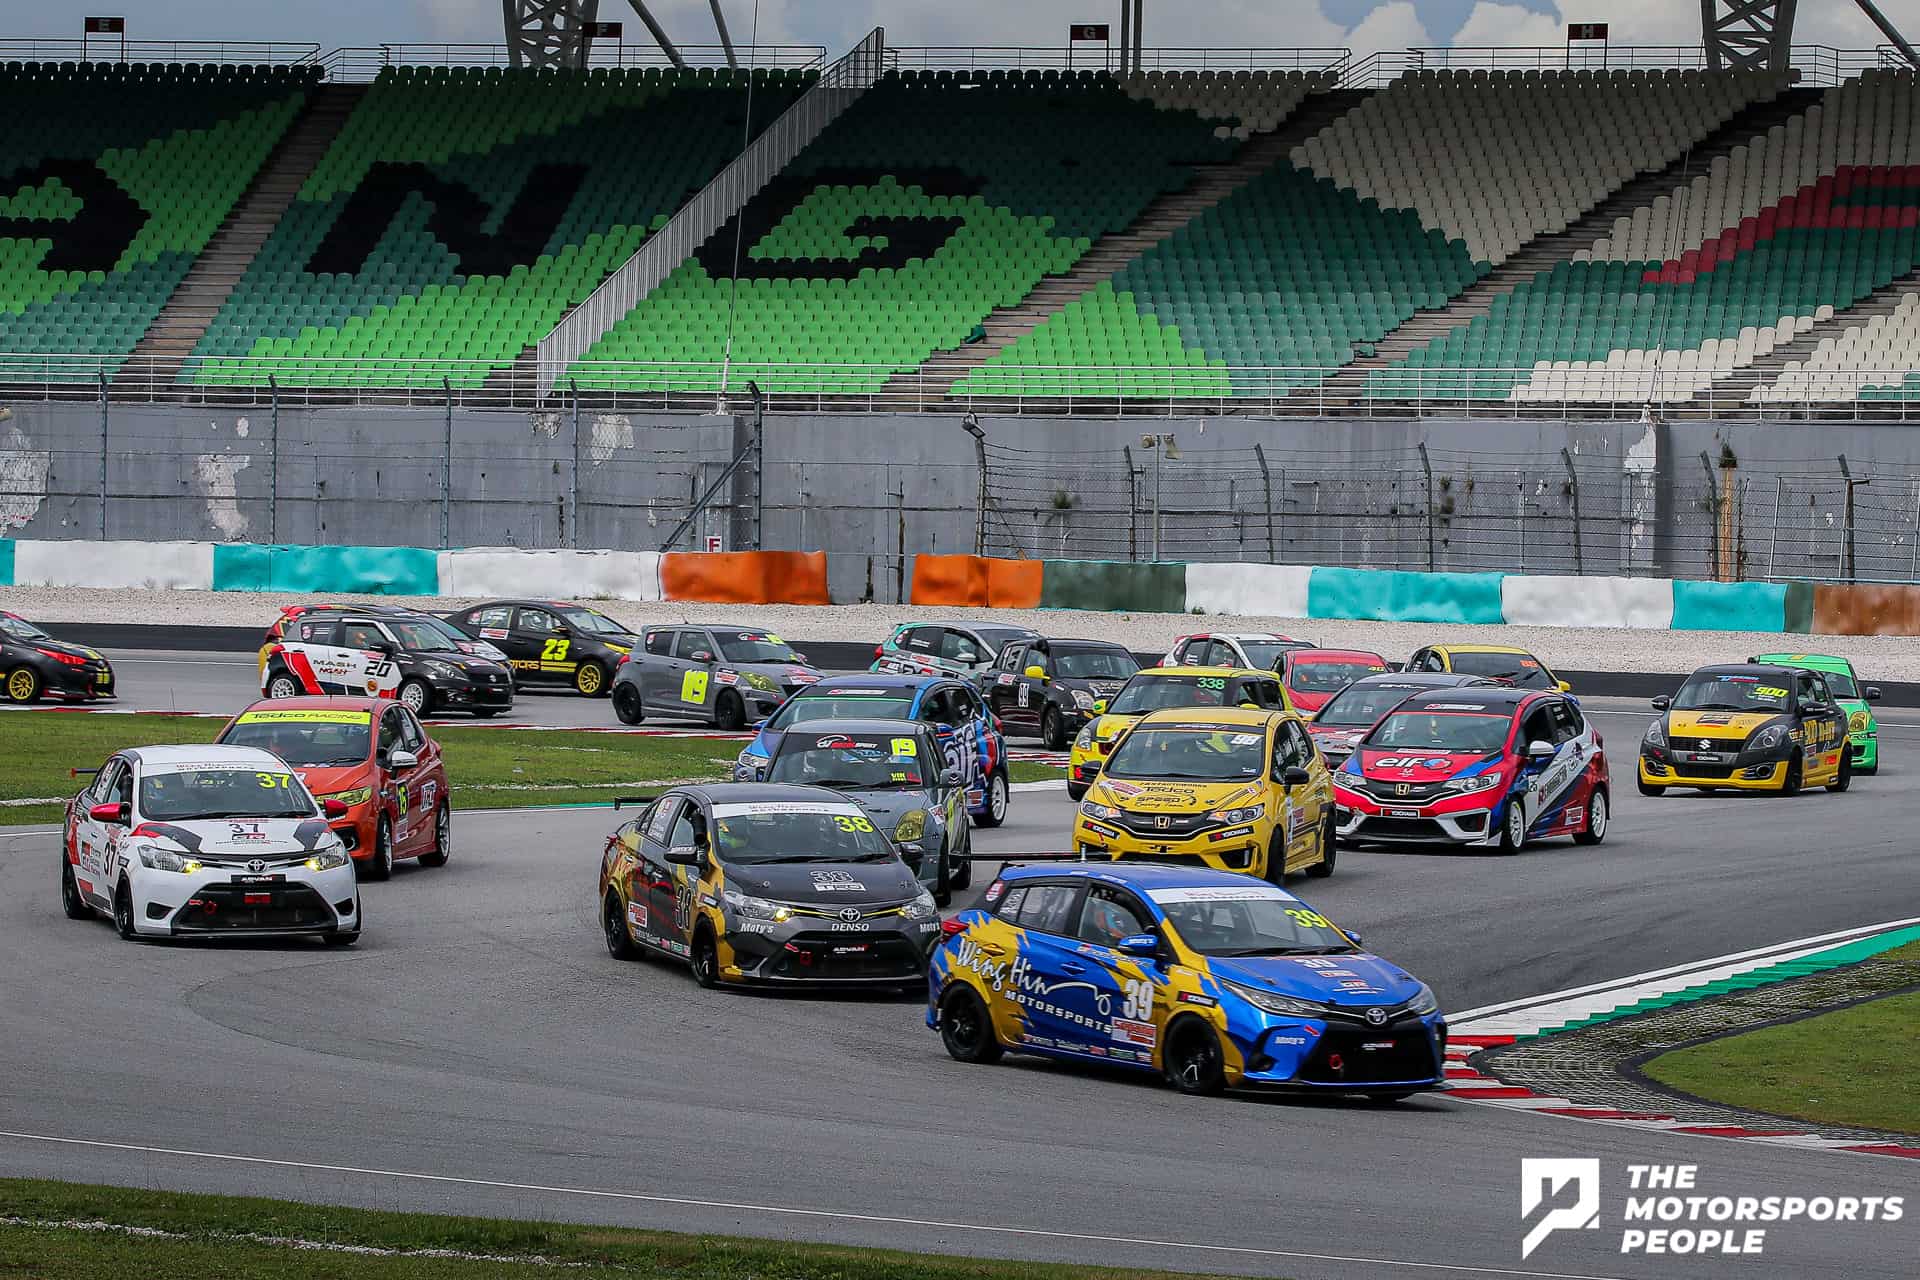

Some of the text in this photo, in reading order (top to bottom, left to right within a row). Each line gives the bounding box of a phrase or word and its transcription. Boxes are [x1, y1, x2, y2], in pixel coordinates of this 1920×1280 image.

[1083, 27, 1096, 39] G
[1582, 25, 1593, 38] H
[541, 638, 572, 661] 23
[364, 660, 393, 678] 20
[1198, 677, 1225, 690] 338
[1754, 686, 1789, 698] 900
[890, 737, 917, 757] 19
[1375, 757, 1427, 768] elf
[256, 772, 290, 790] 37
[228, 823, 260, 834] 37
[833, 815, 875, 833] 38
[104, 842, 116, 878] 37
[811, 870, 854, 883] 38
[673, 883, 693, 930] 38
[831, 922, 870, 932] DENSO
[1284, 908, 1328, 929] 39
[740, 922, 774, 935] Moty's
[955, 937, 1007, 992] Wing
[1295, 958, 1340, 968] 39
[1122, 978, 1153, 1020] 39
[1003, 989, 1113, 1035] MOTORSPORTS
